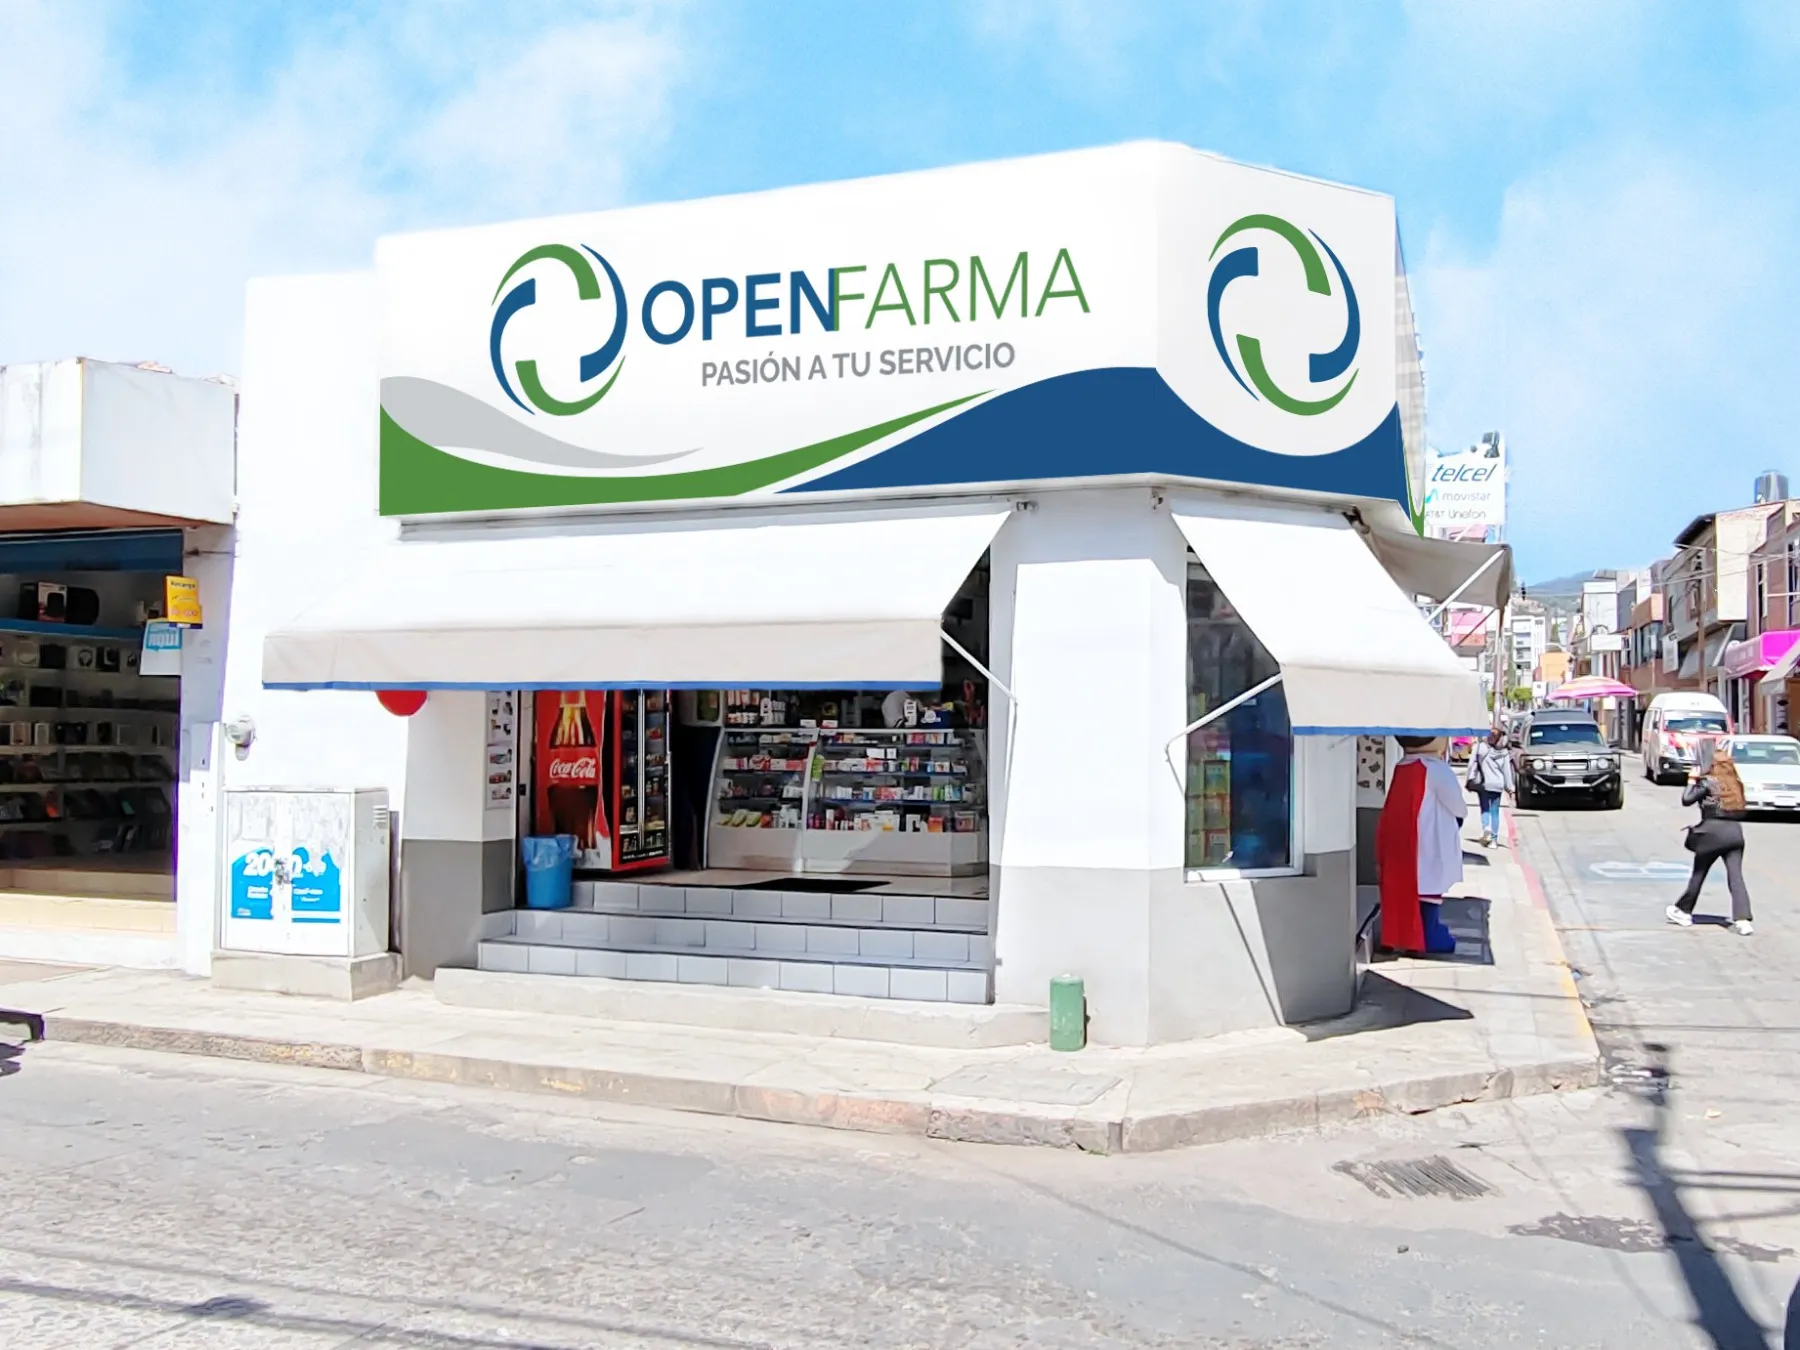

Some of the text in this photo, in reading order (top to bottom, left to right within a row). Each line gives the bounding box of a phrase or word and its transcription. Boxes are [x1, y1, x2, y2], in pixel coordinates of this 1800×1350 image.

[642, 248, 1091, 345] OPENFARMA
[701, 342, 1016, 387] PASIÓN A TU SERVICIO
[1432, 463, 1498, 482] telcel
[1442, 492, 1492, 501] movistar
